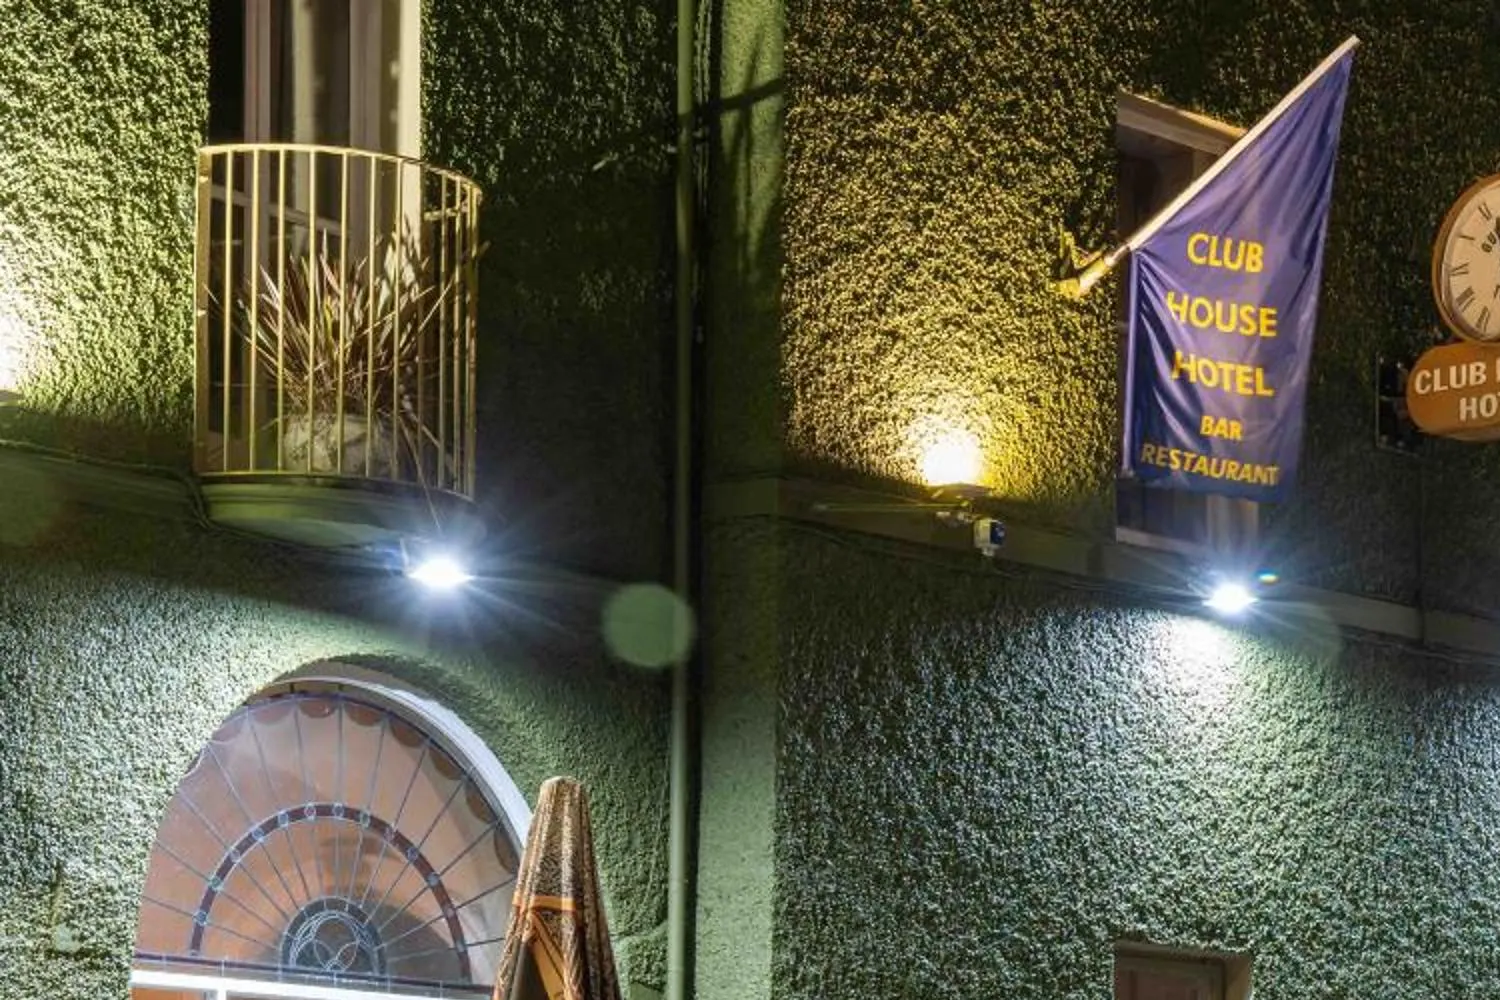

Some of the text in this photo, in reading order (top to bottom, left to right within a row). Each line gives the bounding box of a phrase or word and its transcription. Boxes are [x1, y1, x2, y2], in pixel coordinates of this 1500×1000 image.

[1186, 233, 1264, 273] CLUB
[1166, 291, 1279, 338] HOUSE
[1170, 350, 1275, 397] HOTEL
[1414, 361, 1487, 395] CLUB
[1200, 415, 1244, 441] BAR
[1140, 443, 1280, 486] RESTAURANT
